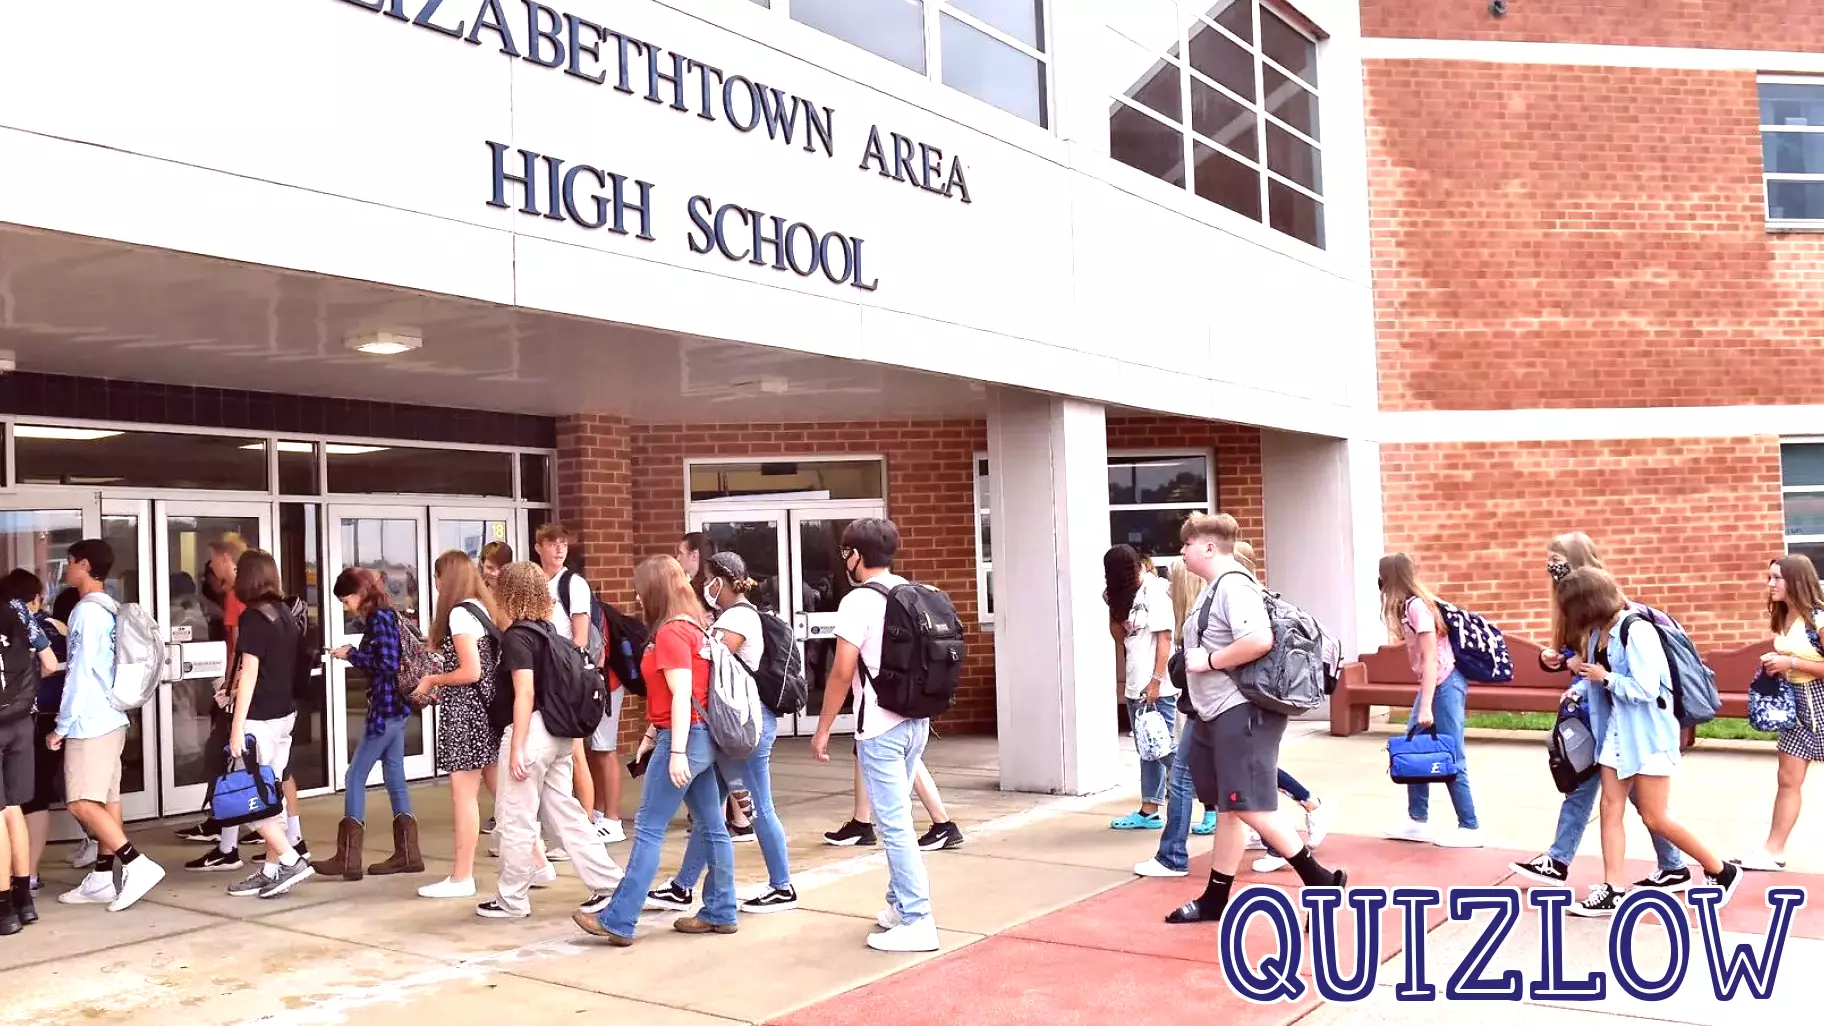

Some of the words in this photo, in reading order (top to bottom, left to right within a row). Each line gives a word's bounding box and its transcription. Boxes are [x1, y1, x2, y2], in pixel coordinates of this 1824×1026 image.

[333, 0, 835, 157] ABETHTOWN
[859, 124, 972, 203] AREA
[485, 141, 655, 241] HIGH
[687, 195, 878, 291] SCHOOL
[492, 523, 504, 538] 18
